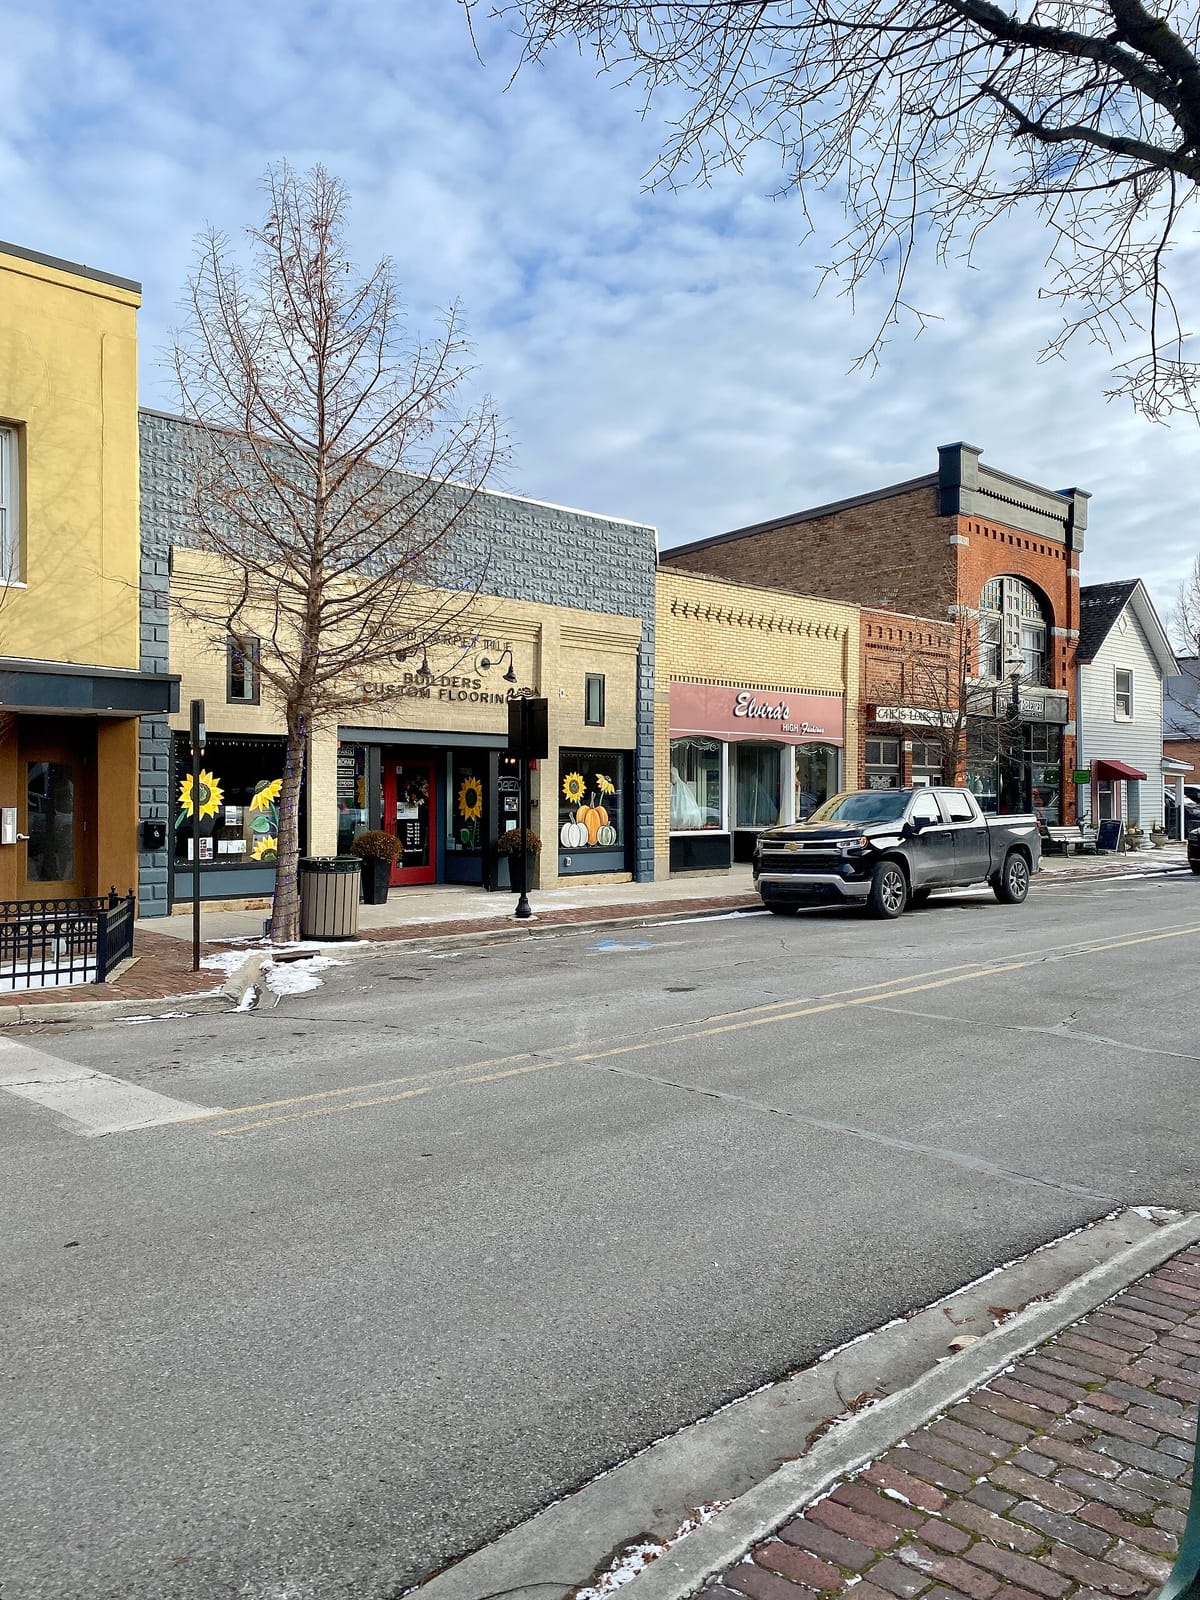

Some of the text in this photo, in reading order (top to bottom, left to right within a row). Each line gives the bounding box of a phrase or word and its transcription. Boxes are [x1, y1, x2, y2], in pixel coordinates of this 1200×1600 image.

[483, 639, 513, 652] TILE
[403, 673, 482, 690] BUILDERS
[363, 682, 431, 699] CUSTOM
[733, 691, 791, 720] Elvira's
[781, 723, 799, 733] HIGH
